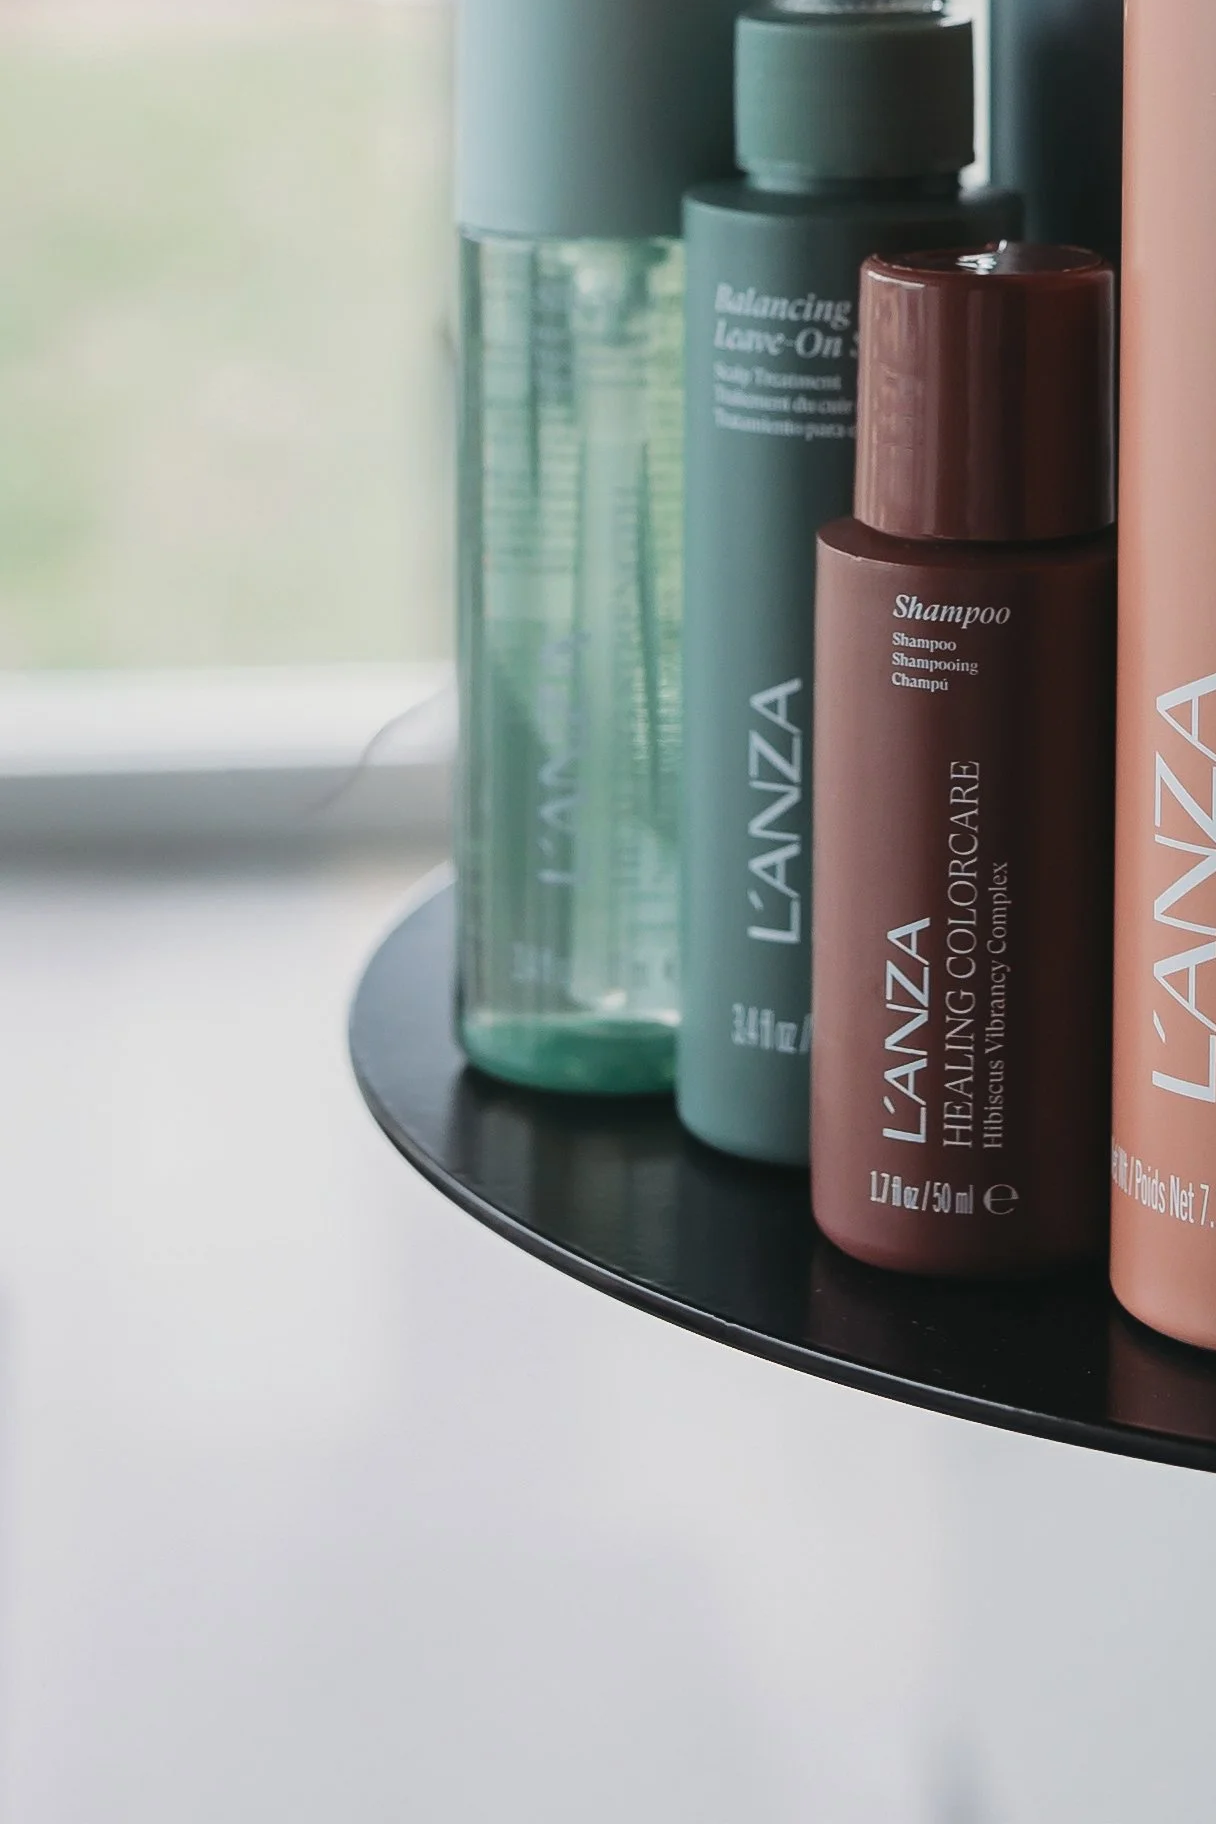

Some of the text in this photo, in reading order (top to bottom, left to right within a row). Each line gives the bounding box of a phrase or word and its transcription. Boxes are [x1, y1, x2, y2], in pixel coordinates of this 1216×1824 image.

[893, 593, 1011, 629] Shampoo
[892, 631, 957, 652] Shampoo
[892, 651, 979, 675] Shampooing
[891, 671, 949, 692] Champú
[748, 678, 801, 944] L'ANZA
[943, 760, 980, 1148] HEALING COLORCARE
[882, 917, 931, 1143] L'ANZA
[983, 861, 1012, 1149] Hibiscus Vibrancy Complex
[870, 1170, 890, 1204] 1.7
[903, 1186, 919, 1210] oz
[932, 1182, 952, 1213] 50
[955, 1184, 974, 1214] ml
[1134, 1159, 1166, 1214] Poids
[1169, 1174, 1195, 1224] Net
